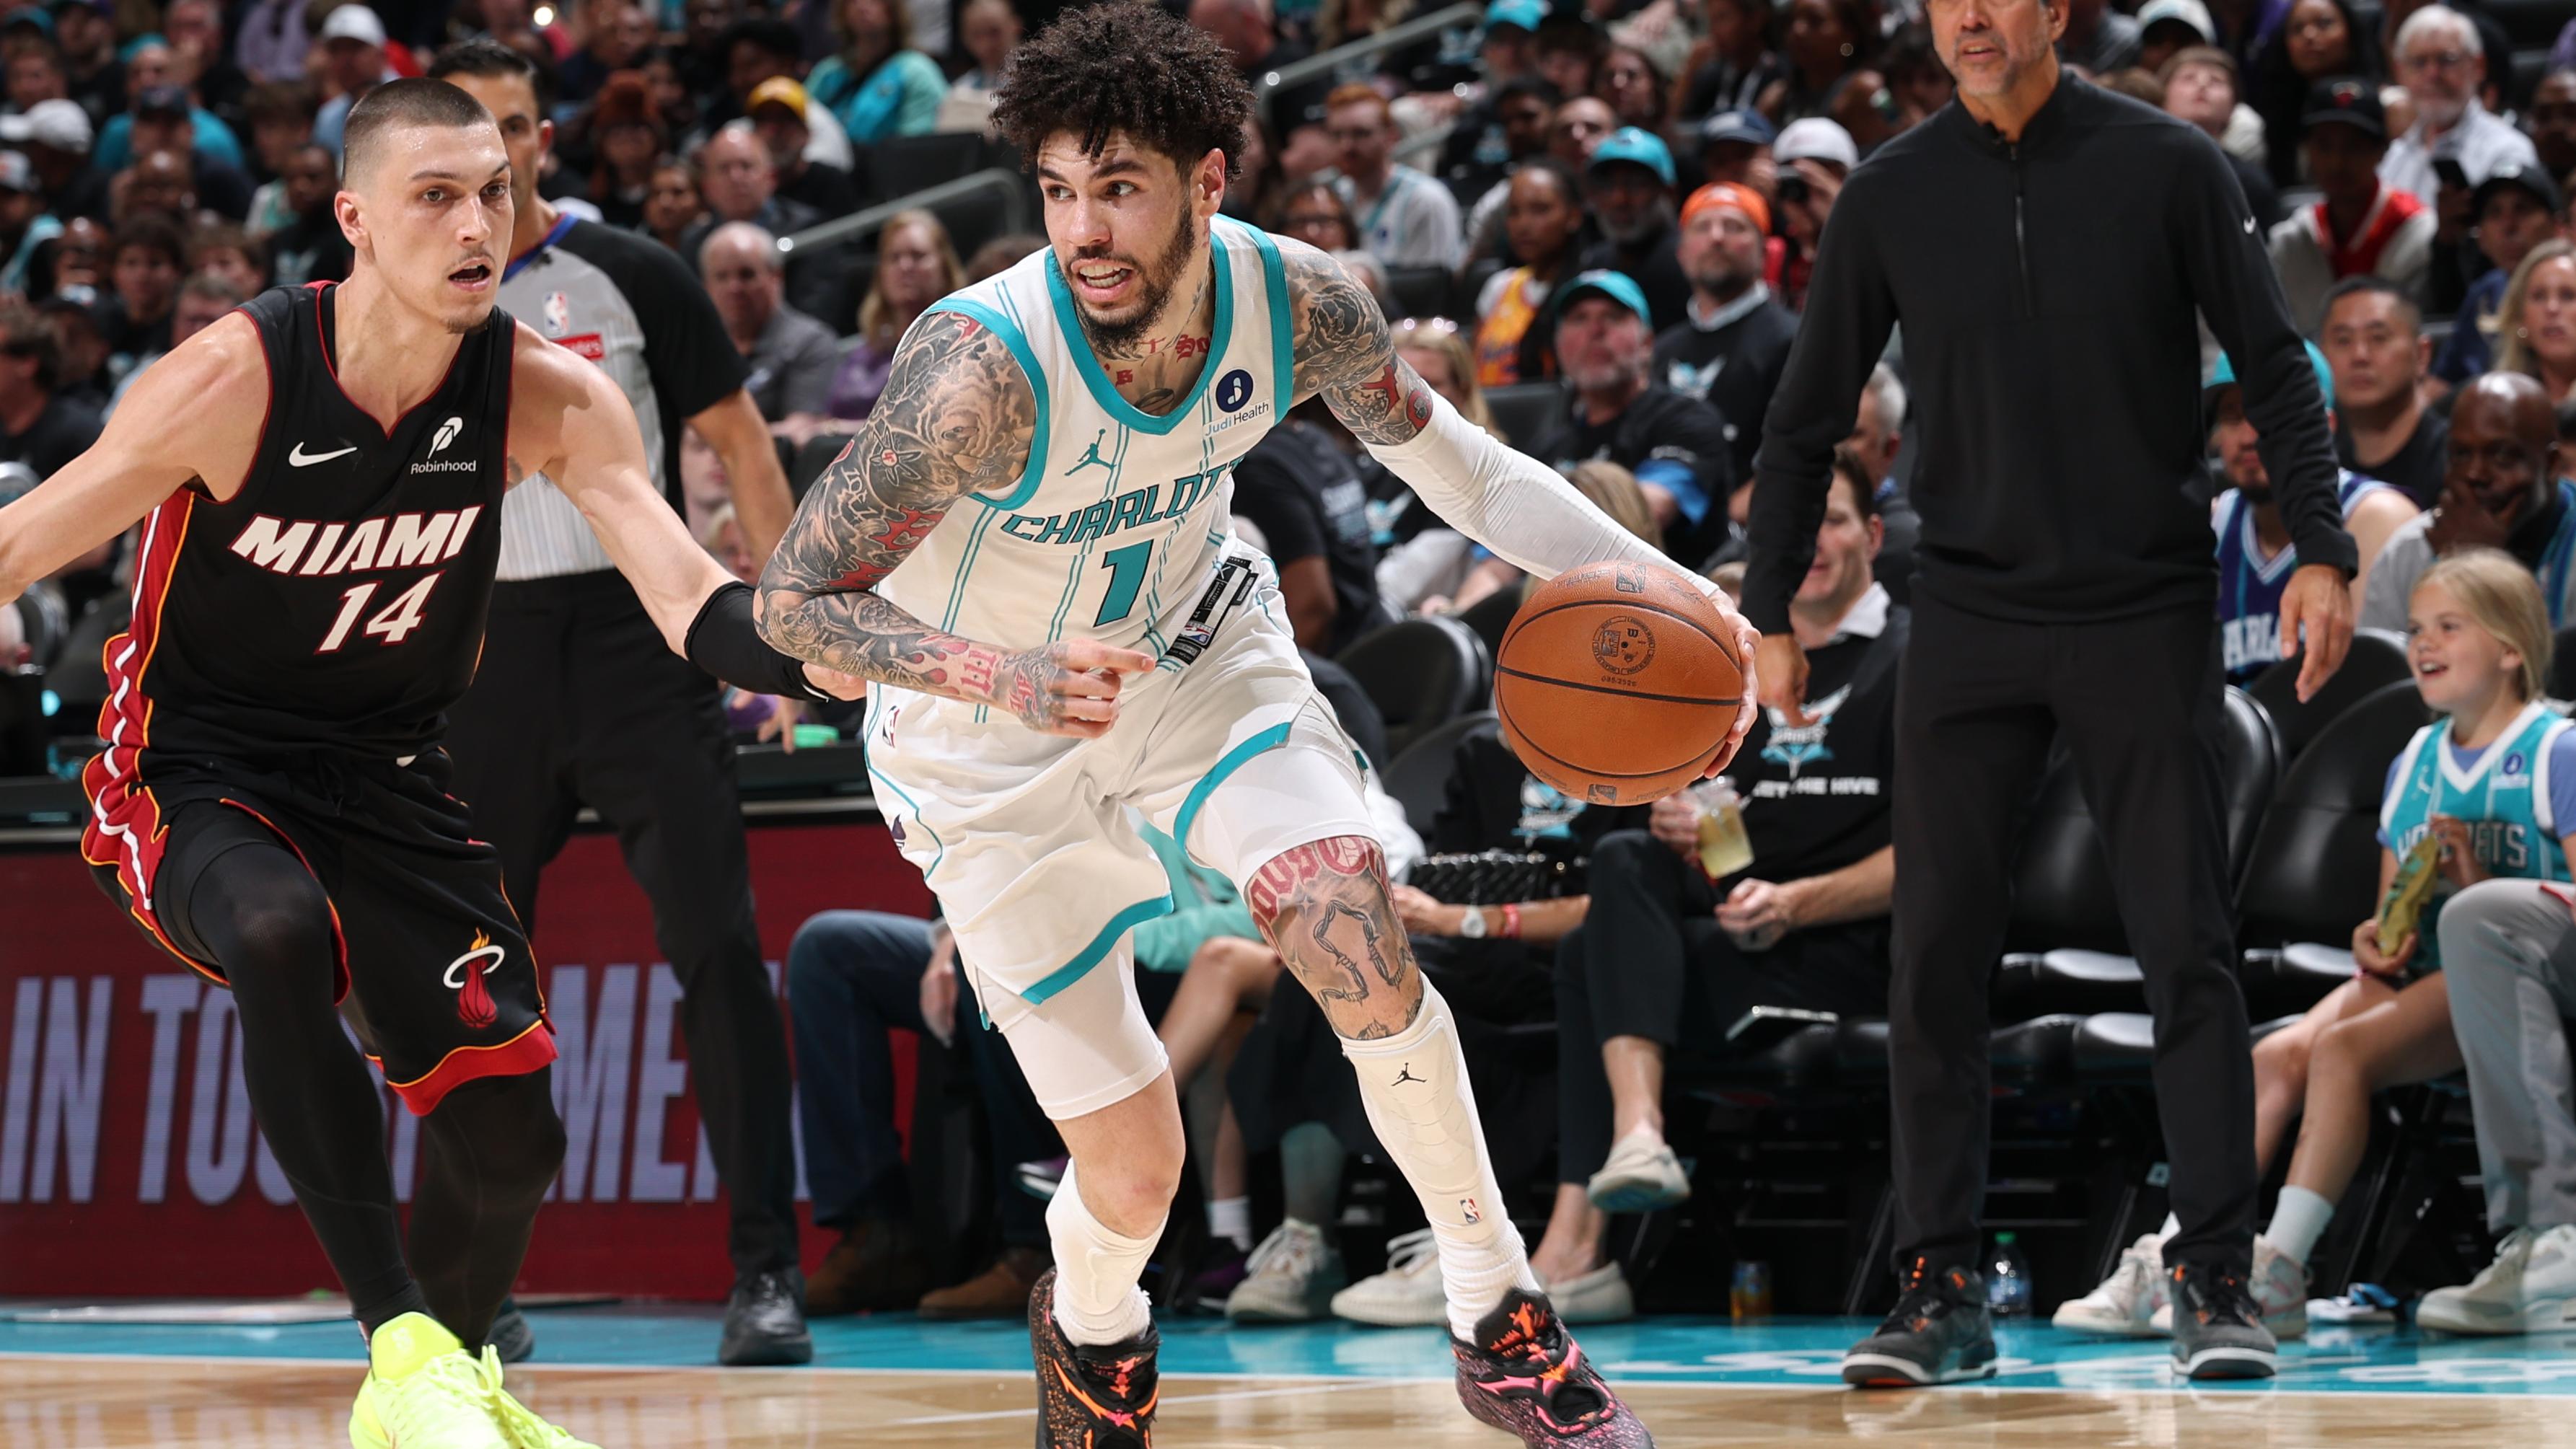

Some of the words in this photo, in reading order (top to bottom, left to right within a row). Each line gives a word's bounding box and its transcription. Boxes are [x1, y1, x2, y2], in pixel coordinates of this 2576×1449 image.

[1205, 416, 1232, 436] Judi
[1233, 402, 1270, 426] Health
[410, 459, 477, 475] Robinhood
[227, 503, 485, 576] MIAMI
[313, 569, 447, 656] 14
[1092, 538, 1155, 628] 1
